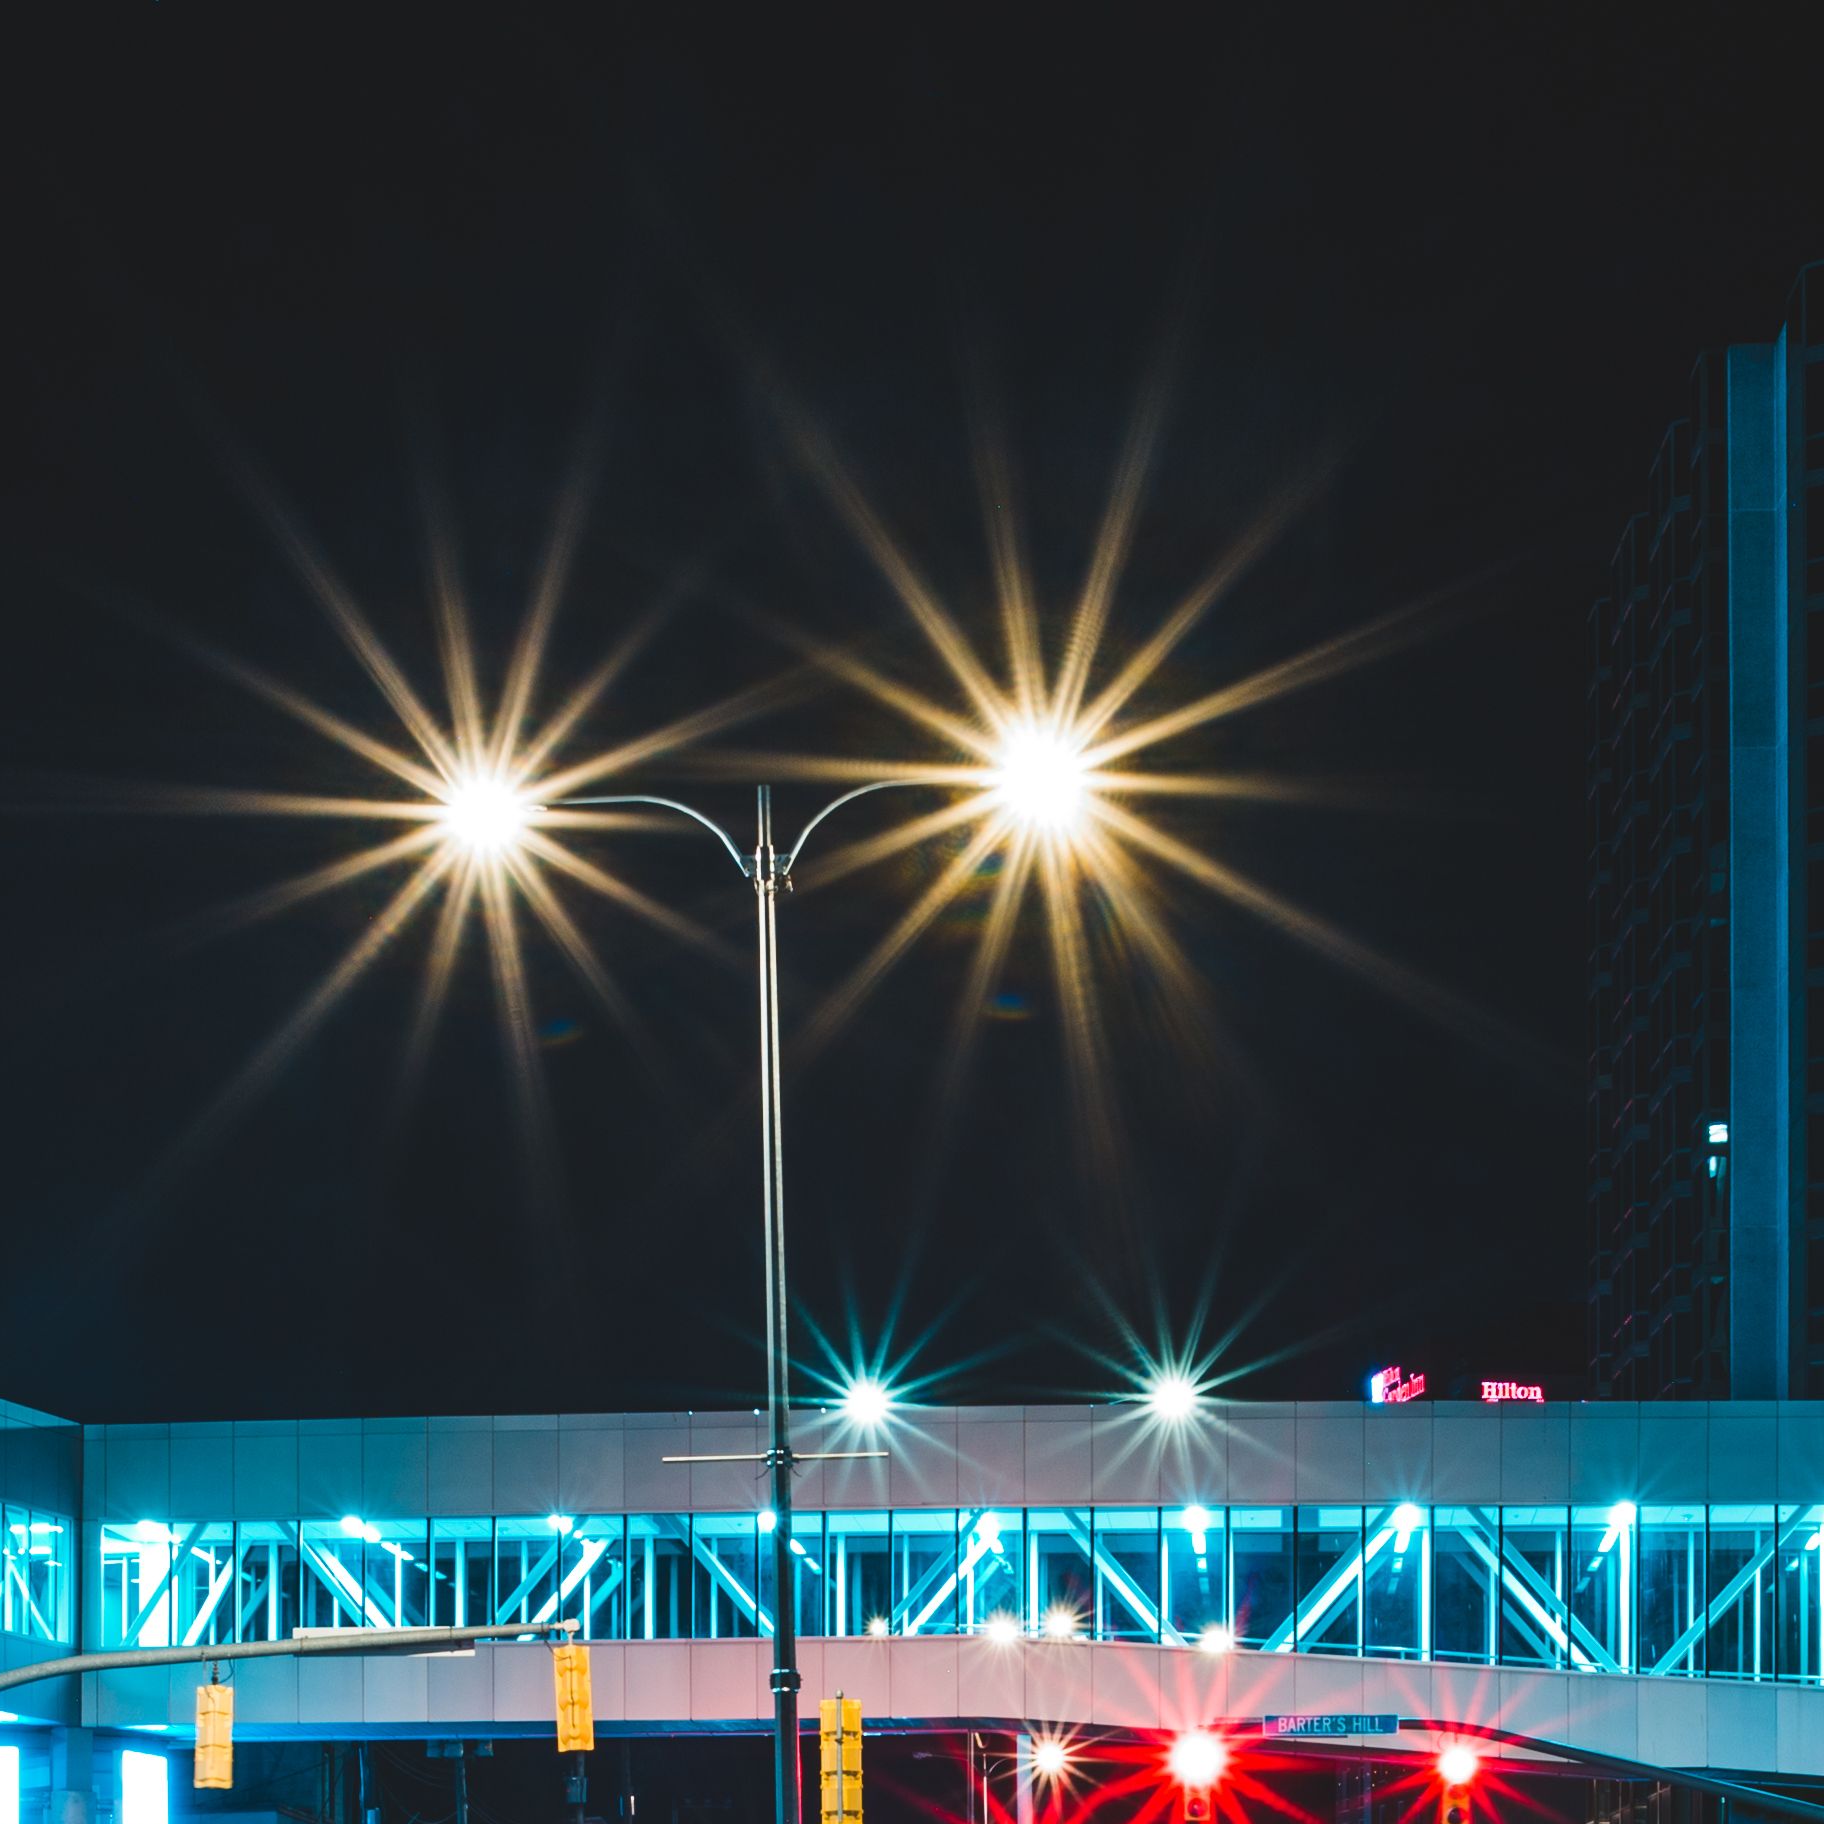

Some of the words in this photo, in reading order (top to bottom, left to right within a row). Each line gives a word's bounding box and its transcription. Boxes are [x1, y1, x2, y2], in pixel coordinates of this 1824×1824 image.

[1481, 1381, 1543, 1400] Hilton
[1277, 1716, 1347, 1733] BARTER'S
[1352, 1716, 1384, 1733] HILL
